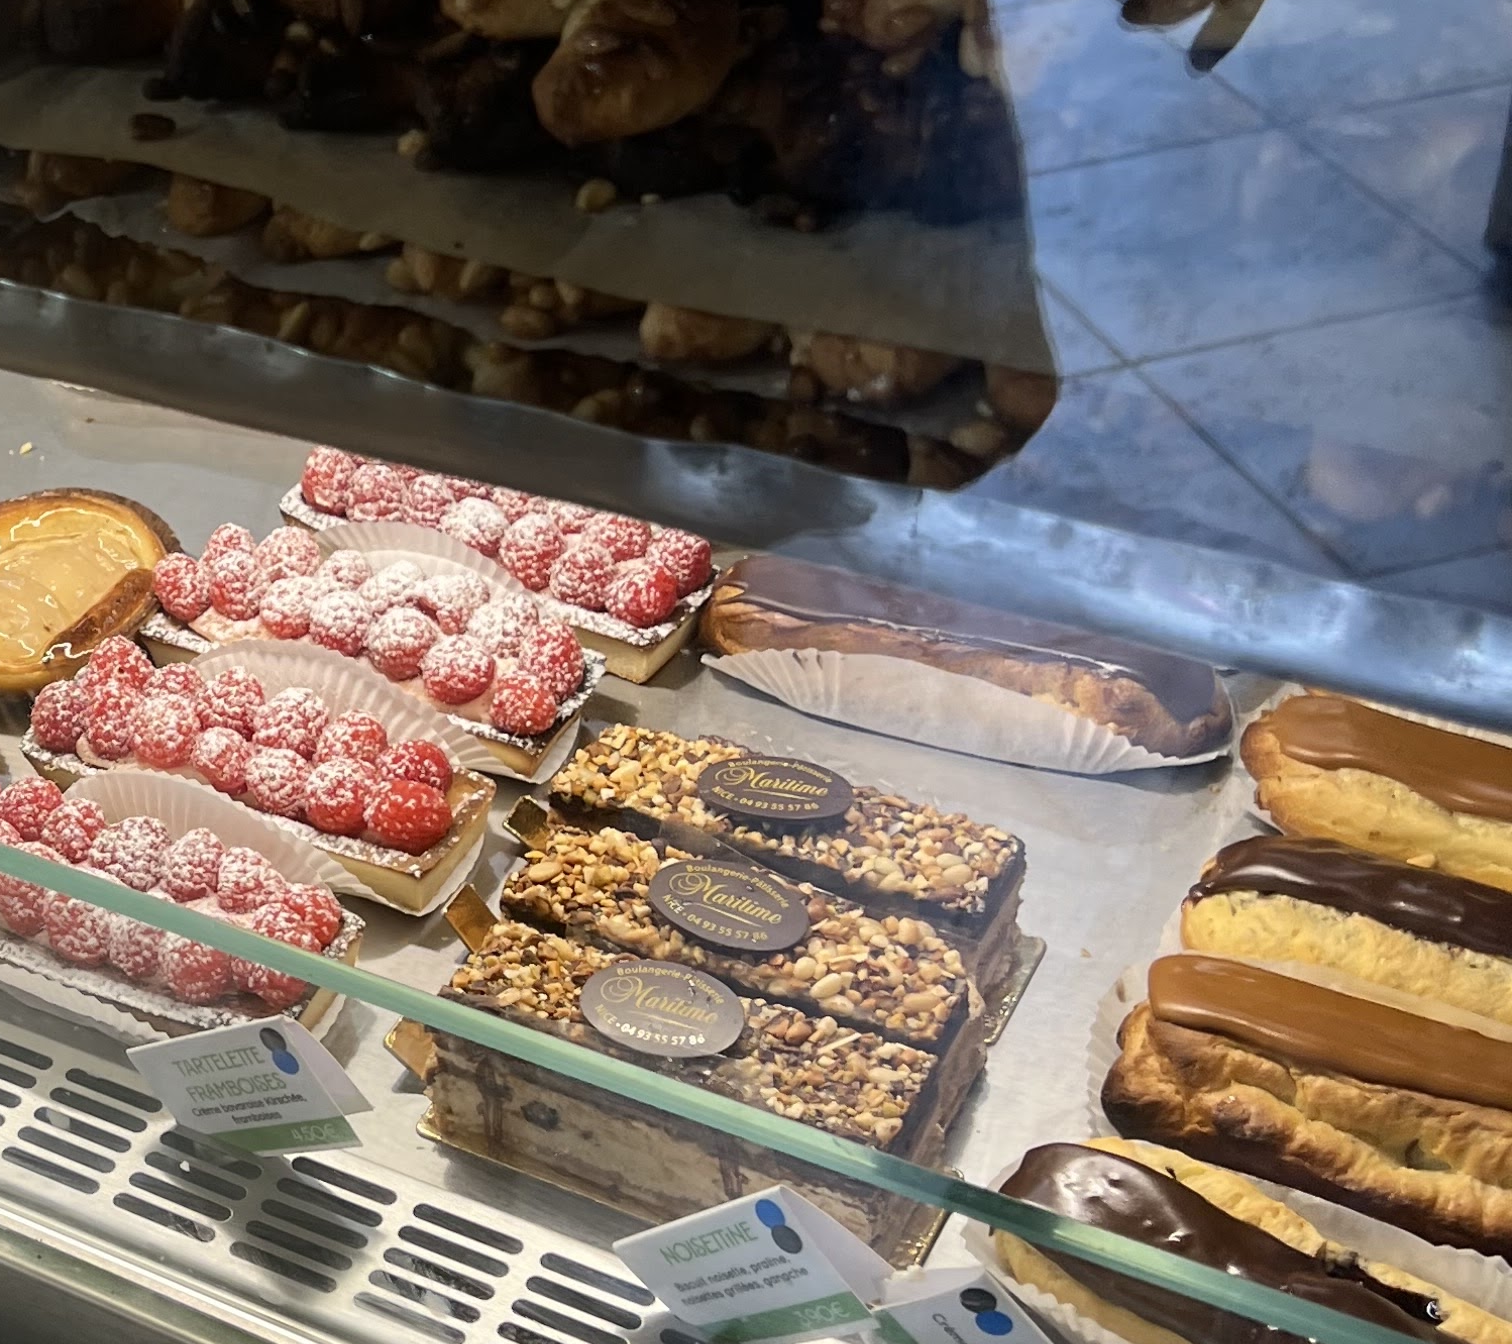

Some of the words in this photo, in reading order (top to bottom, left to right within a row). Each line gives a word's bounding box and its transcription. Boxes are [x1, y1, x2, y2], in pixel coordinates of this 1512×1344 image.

[712, 786, 734, 800] NICE
[662, 894, 684, 914] NICE
[687, 913, 700, 925] 04
[702, 920, 717, 932] 93
[718, 925, 732, 936] 55
[735, 929, 749, 940] 57
[669, 872, 782, 924] Maritime
[600, 975, 718, 1024] Maritime
[595, 1004, 618, 1025] NICE
[621, 1022, 636, 1036] 04
[637, 1029, 651, 1041] 93
[653, 1034, 668, 1045] 55
[671, 1035, 686, 1045] 57
[688, 1033, 706, 1045] 86
[171, 1046, 265, 1077] TARTELETTE
[186, 1072, 287, 1103] FRAMBOISES
